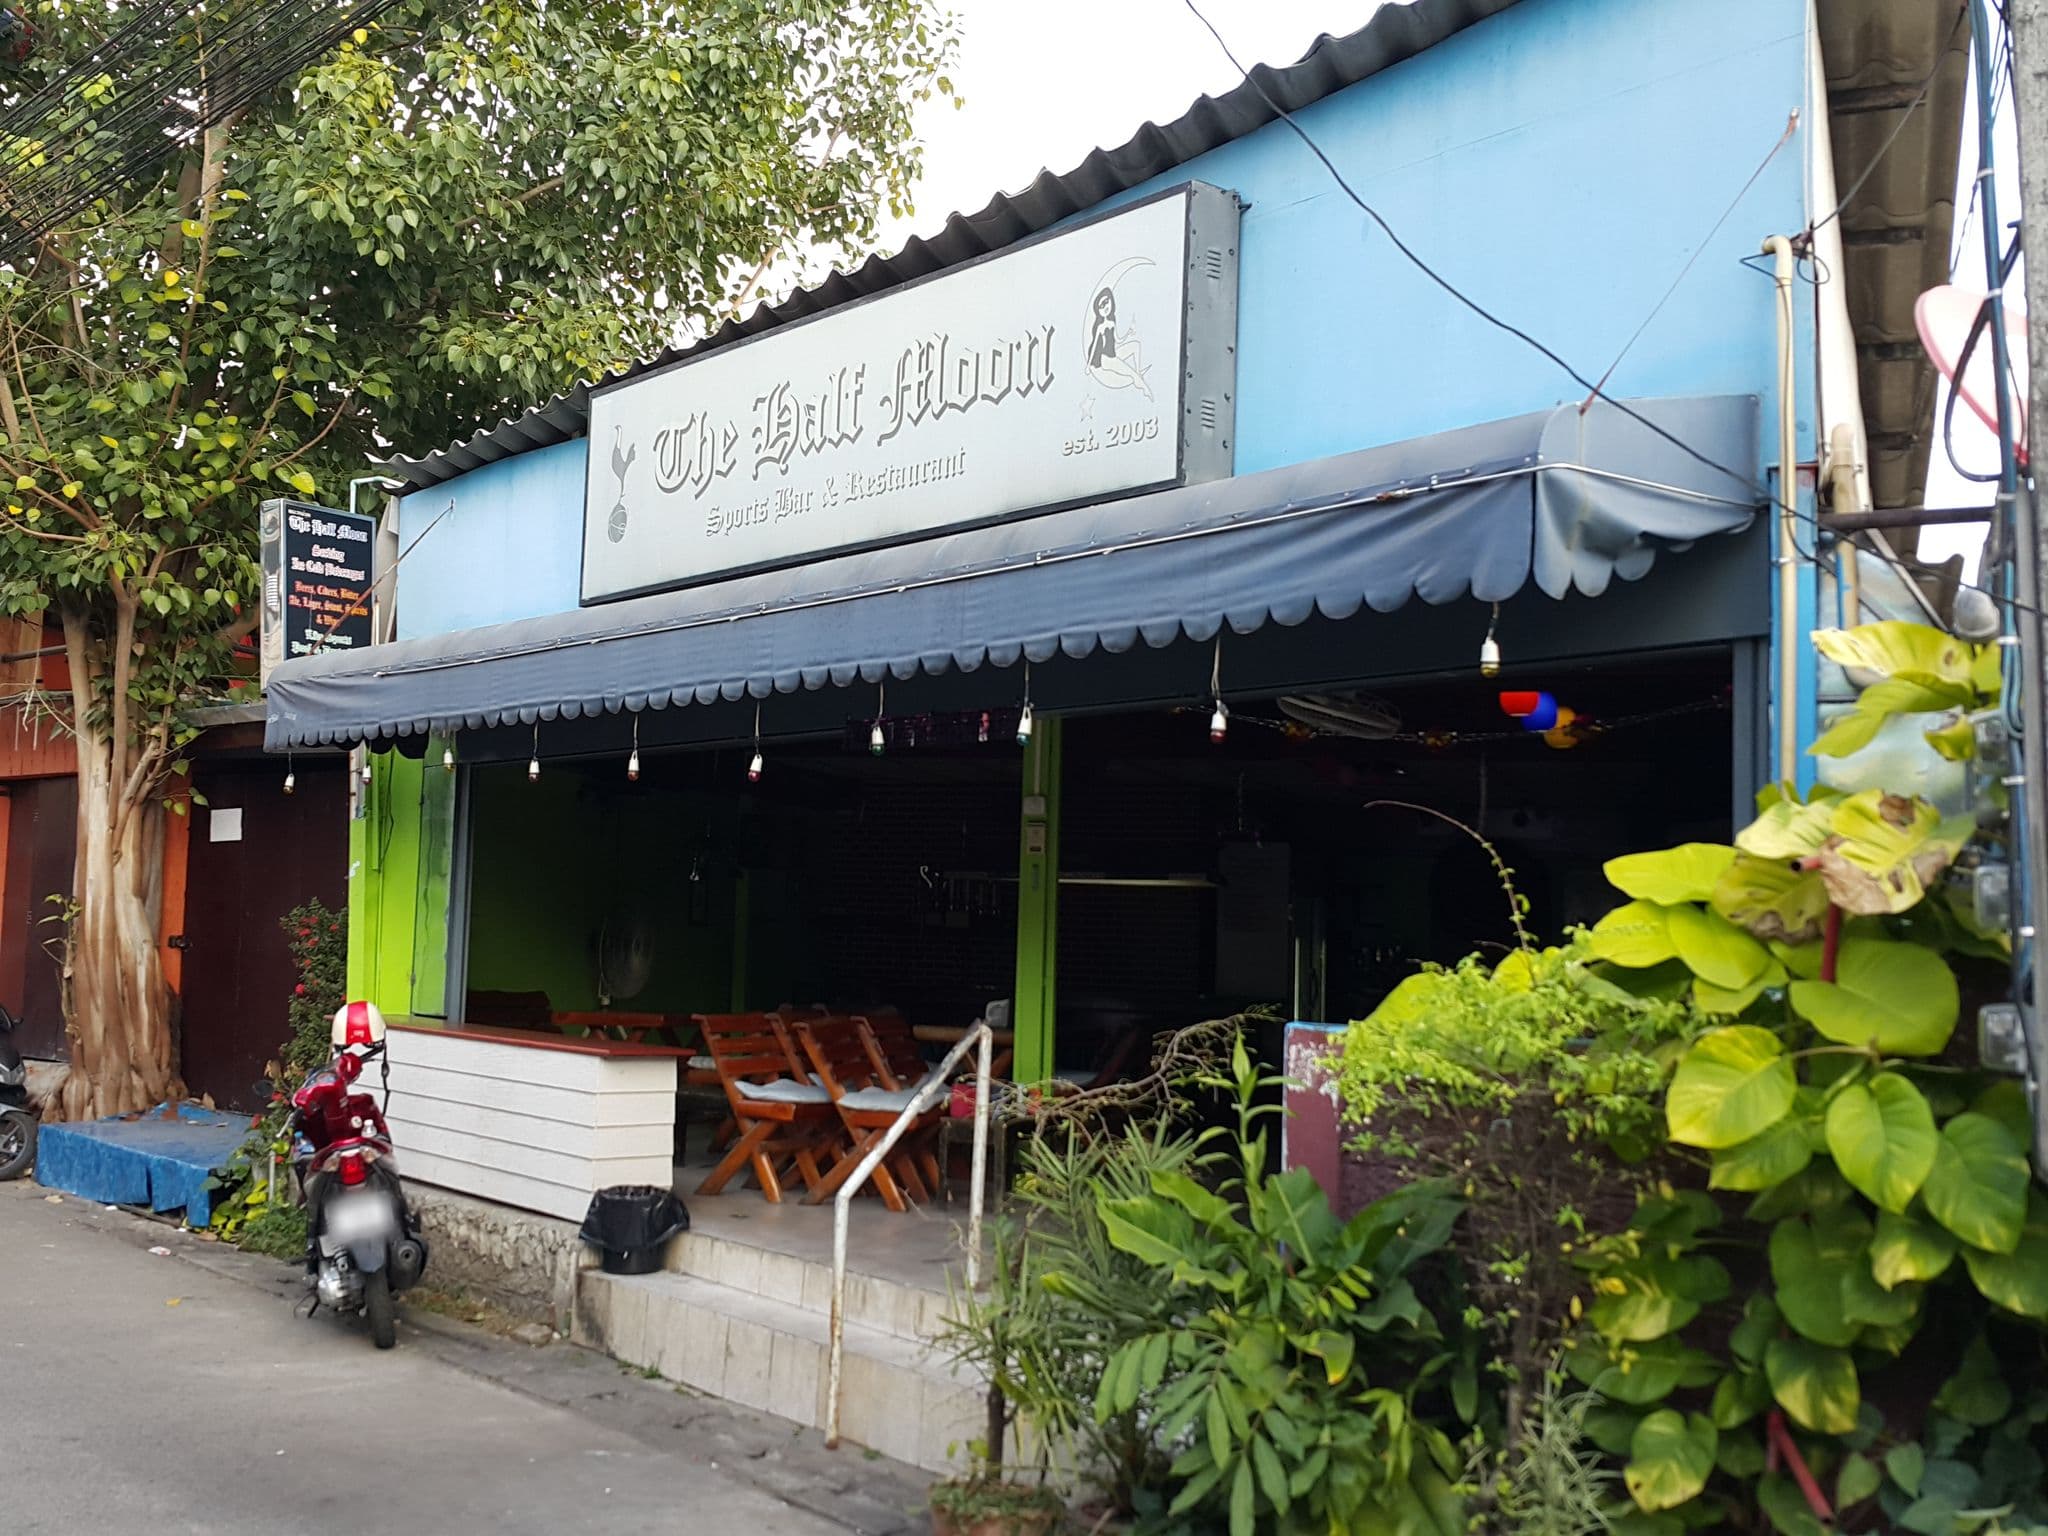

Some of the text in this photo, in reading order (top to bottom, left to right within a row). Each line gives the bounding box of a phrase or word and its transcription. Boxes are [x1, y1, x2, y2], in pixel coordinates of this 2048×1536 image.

[653, 323, 1057, 500] The Half Moon
[1062, 416, 1159, 457] est. 2003
[706, 447, 967, 537] Sports Bar & Restaurant
[289, 515, 311, 533] The
[337, 524, 368, 542] Moon
